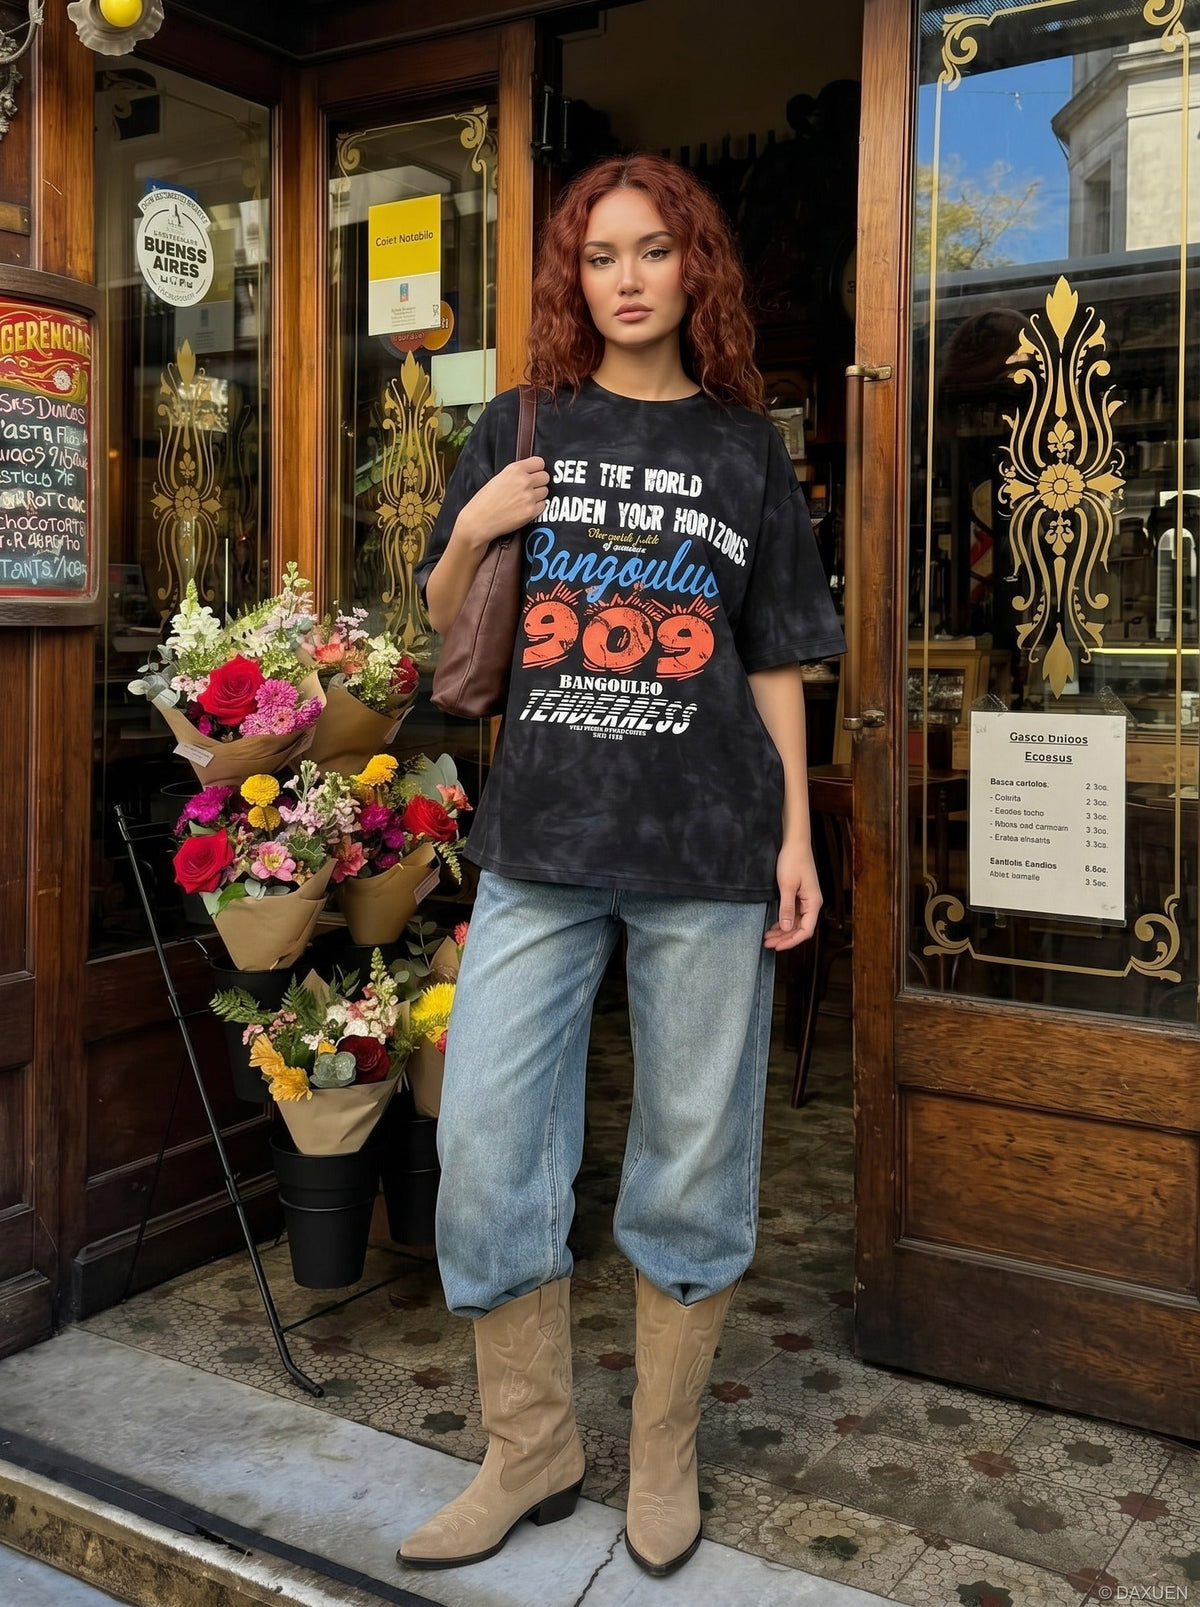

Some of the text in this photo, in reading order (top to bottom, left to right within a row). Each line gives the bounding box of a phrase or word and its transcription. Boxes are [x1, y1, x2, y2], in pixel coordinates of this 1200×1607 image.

[144, 236, 207, 264] BUENSS
[153, 256, 199, 278] AIRES
[553, 460, 702, 498] SEE THE WORLD
[534, 496, 606, 525] ROADEN
[618, 502, 664, 531] YOUR
[673, 507, 749, 567] HORIZONS.
[522, 600, 715, 677] 909
[559, 674, 663, 696] BANGOULEO
[1010, 731, 1044, 743] Gasco
